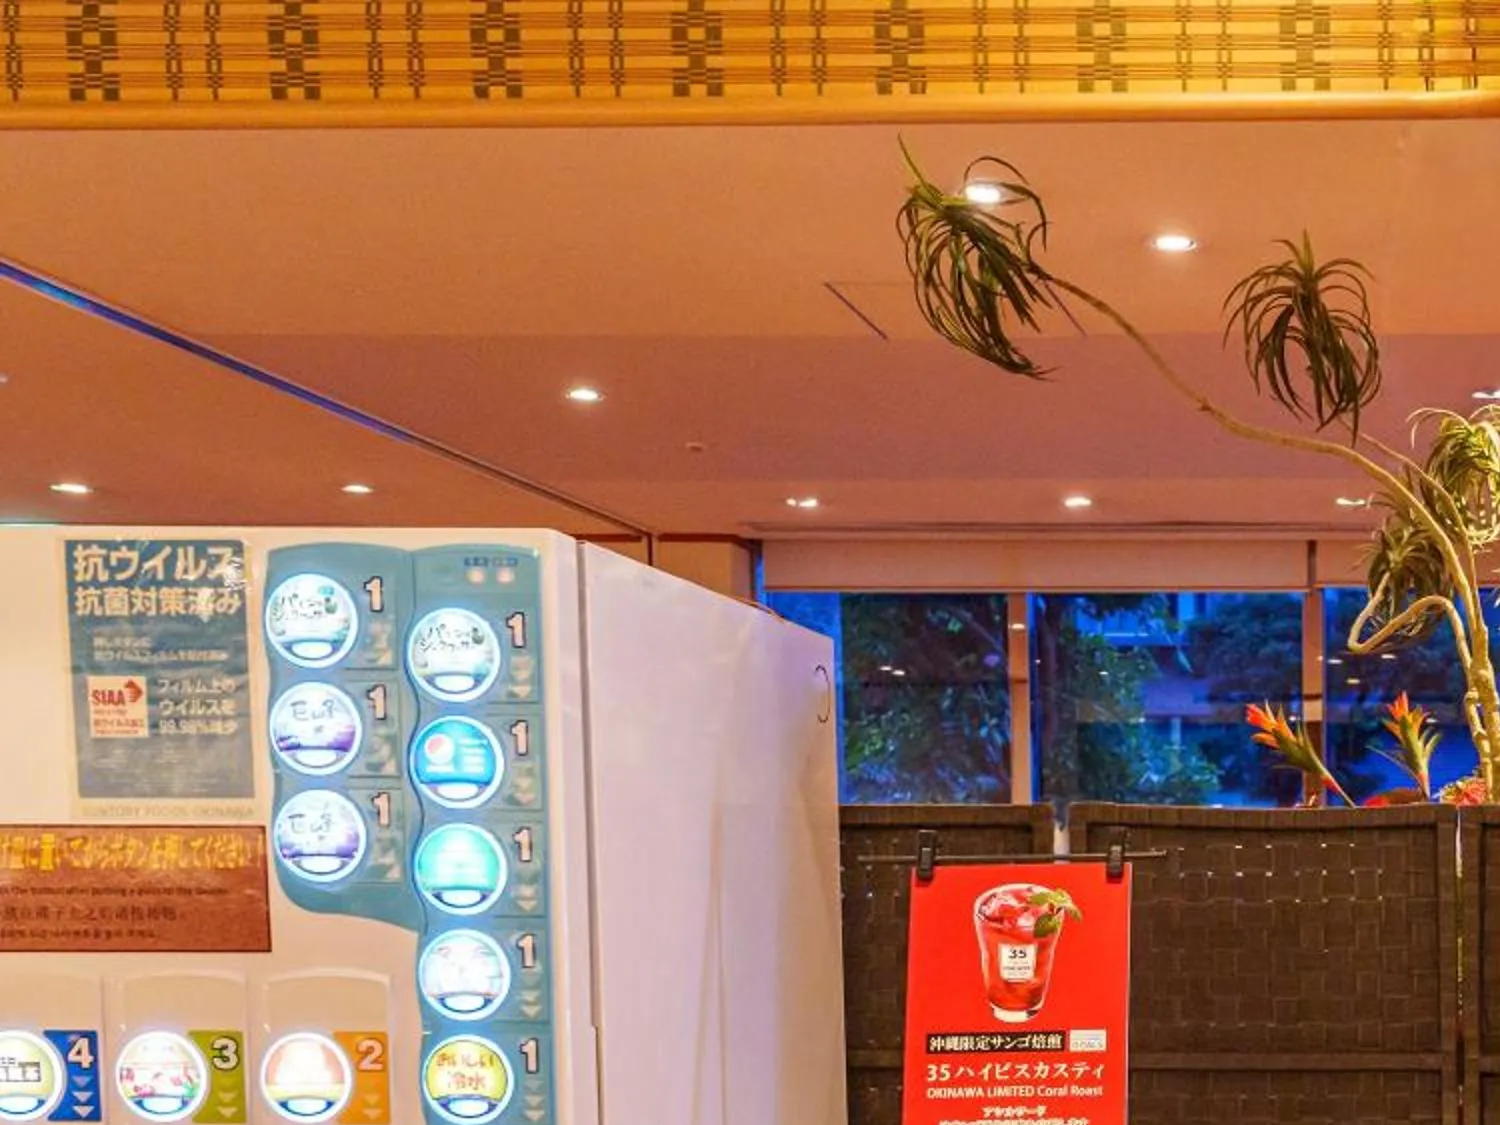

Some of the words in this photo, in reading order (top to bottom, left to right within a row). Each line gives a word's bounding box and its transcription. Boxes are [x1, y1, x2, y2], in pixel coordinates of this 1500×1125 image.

[73, 544, 243, 582] 抗ウイルス
[74, 586, 242, 617] 抗菌対策済み
[363, 575, 385, 613] 1
[506, 611, 527, 648] 1
[92, 689, 126, 706] SIAA
[366, 684, 387, 721] 1
[510, 719, 529, 756] 1
[371, 791, 391, 827] 1
[512, 826, 532, 862] 1
[516, 933, 537, 968] 1
[1008, 949, 1027, 959] 35
[67, 1037, 94, 1069] 4
[211, 1036, 240, 1071] 3
[356, 1038, 385, 1071] 2
[519, 1037, 539, 1074] 1
[927, 1086, 985, 1099] OKINAWA
[987, 1085, 1035, 1098] LIMITED
[1037, 1084, 1068, 1097] Coral
[1071, 1084, 1103, 1097] Roast
